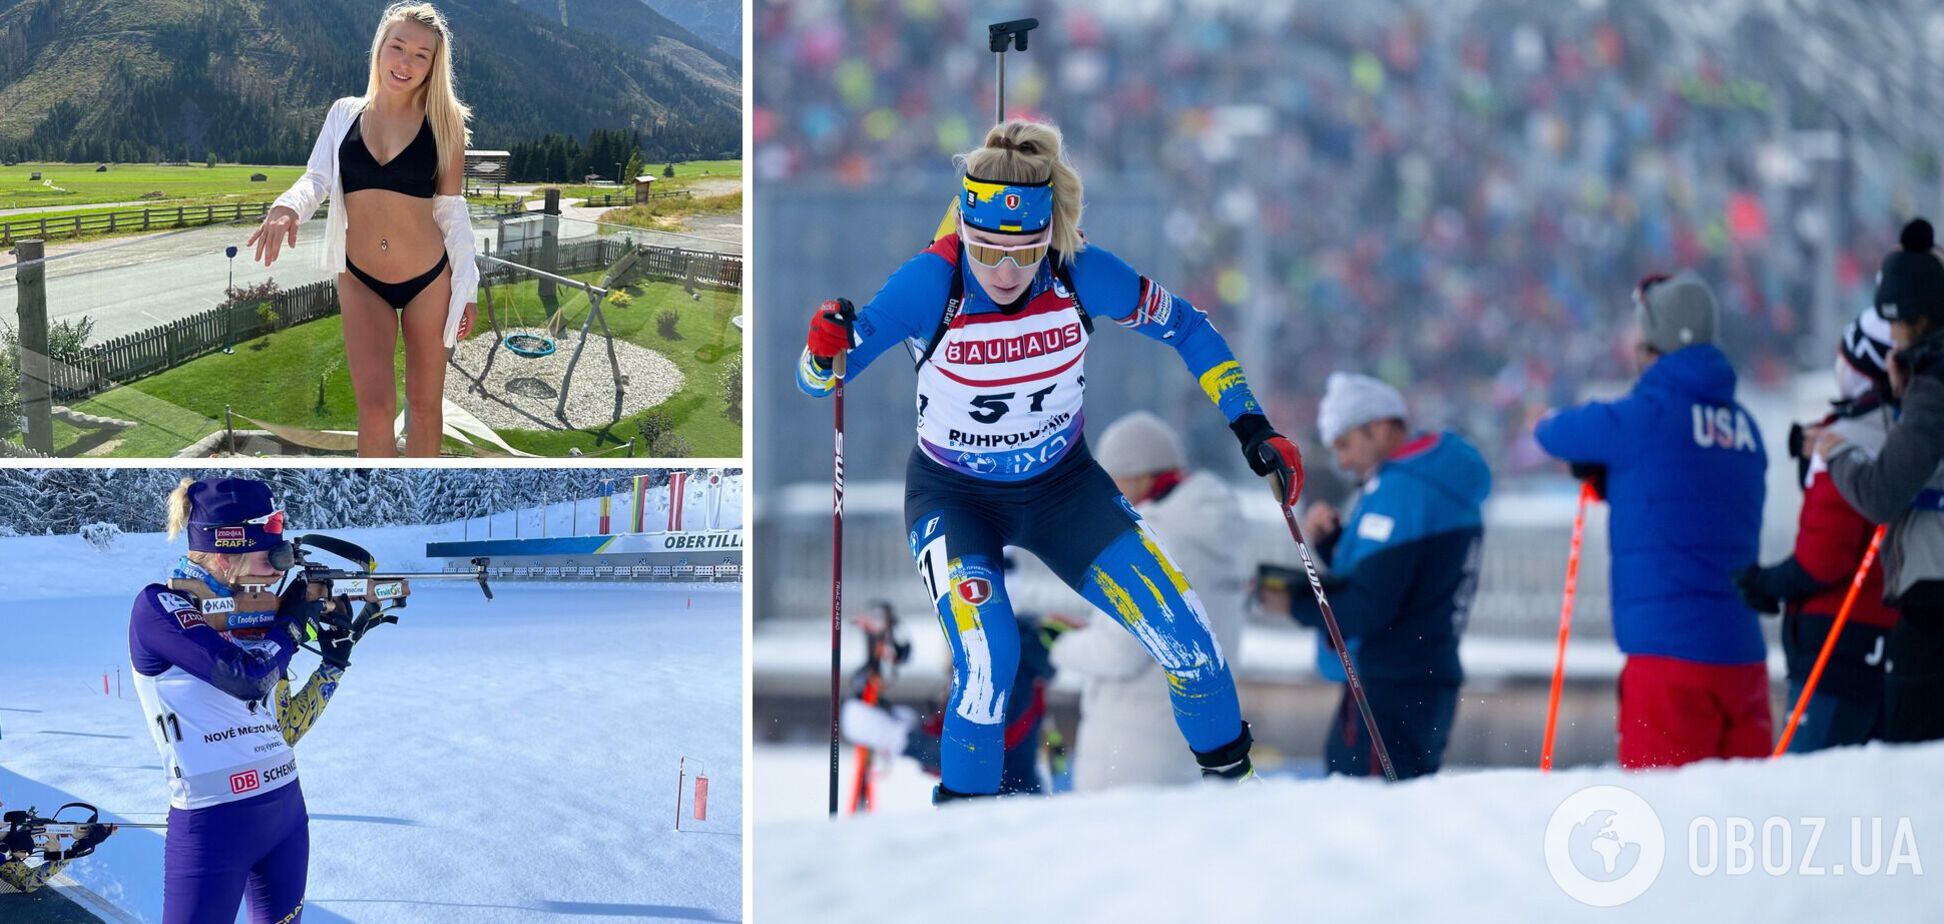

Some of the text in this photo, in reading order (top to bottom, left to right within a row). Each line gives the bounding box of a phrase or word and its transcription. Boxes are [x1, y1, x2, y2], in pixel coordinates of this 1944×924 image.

[948, 326, 1080, 362] BAUHAUS
[1691, 404, 1757, 453] USA
[214, 539, 248, 548] CRAFT
[664, 533, 744, 549] OBERTILL
[966, 581, 985, 600] 1
[212, 600, 234, 610] KAN
[156, 712, 184, 743] 11
[204, 727, 236, 744] NOVÉ
[233, 774, 256, 791] DB
